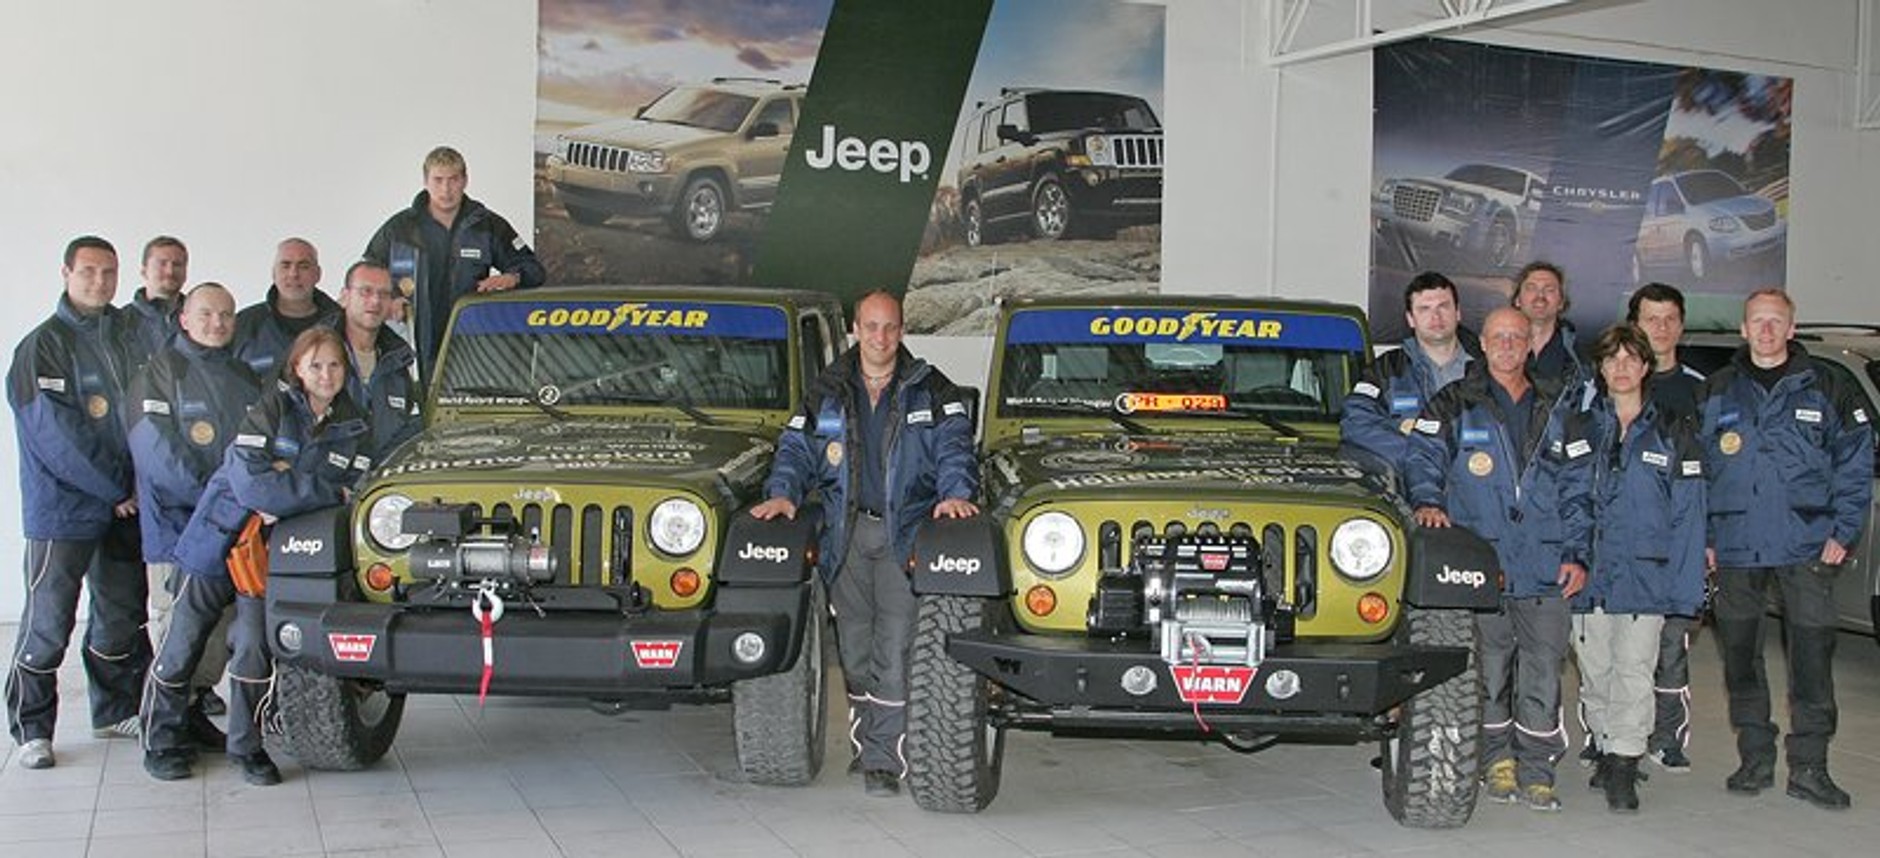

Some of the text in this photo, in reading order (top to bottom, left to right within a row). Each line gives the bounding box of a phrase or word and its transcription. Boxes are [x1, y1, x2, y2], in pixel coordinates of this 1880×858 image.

[806, 125, 931, 182] Jeep
[1553, 186, 1641, 200] CHRYSLER
[1006, 397, 1033, 405] World
[281, 536, 323, 556] Jeep
[738, 542, 789, 563] Jeep
[928, 554, 981, 575] Jeep
[1437, 566, 1487, 588] Jeep
[336, 641, 368, 652] WARN
[639, 649, 673, 659] WARN
[1182, 677, 1241, 692] WARN
